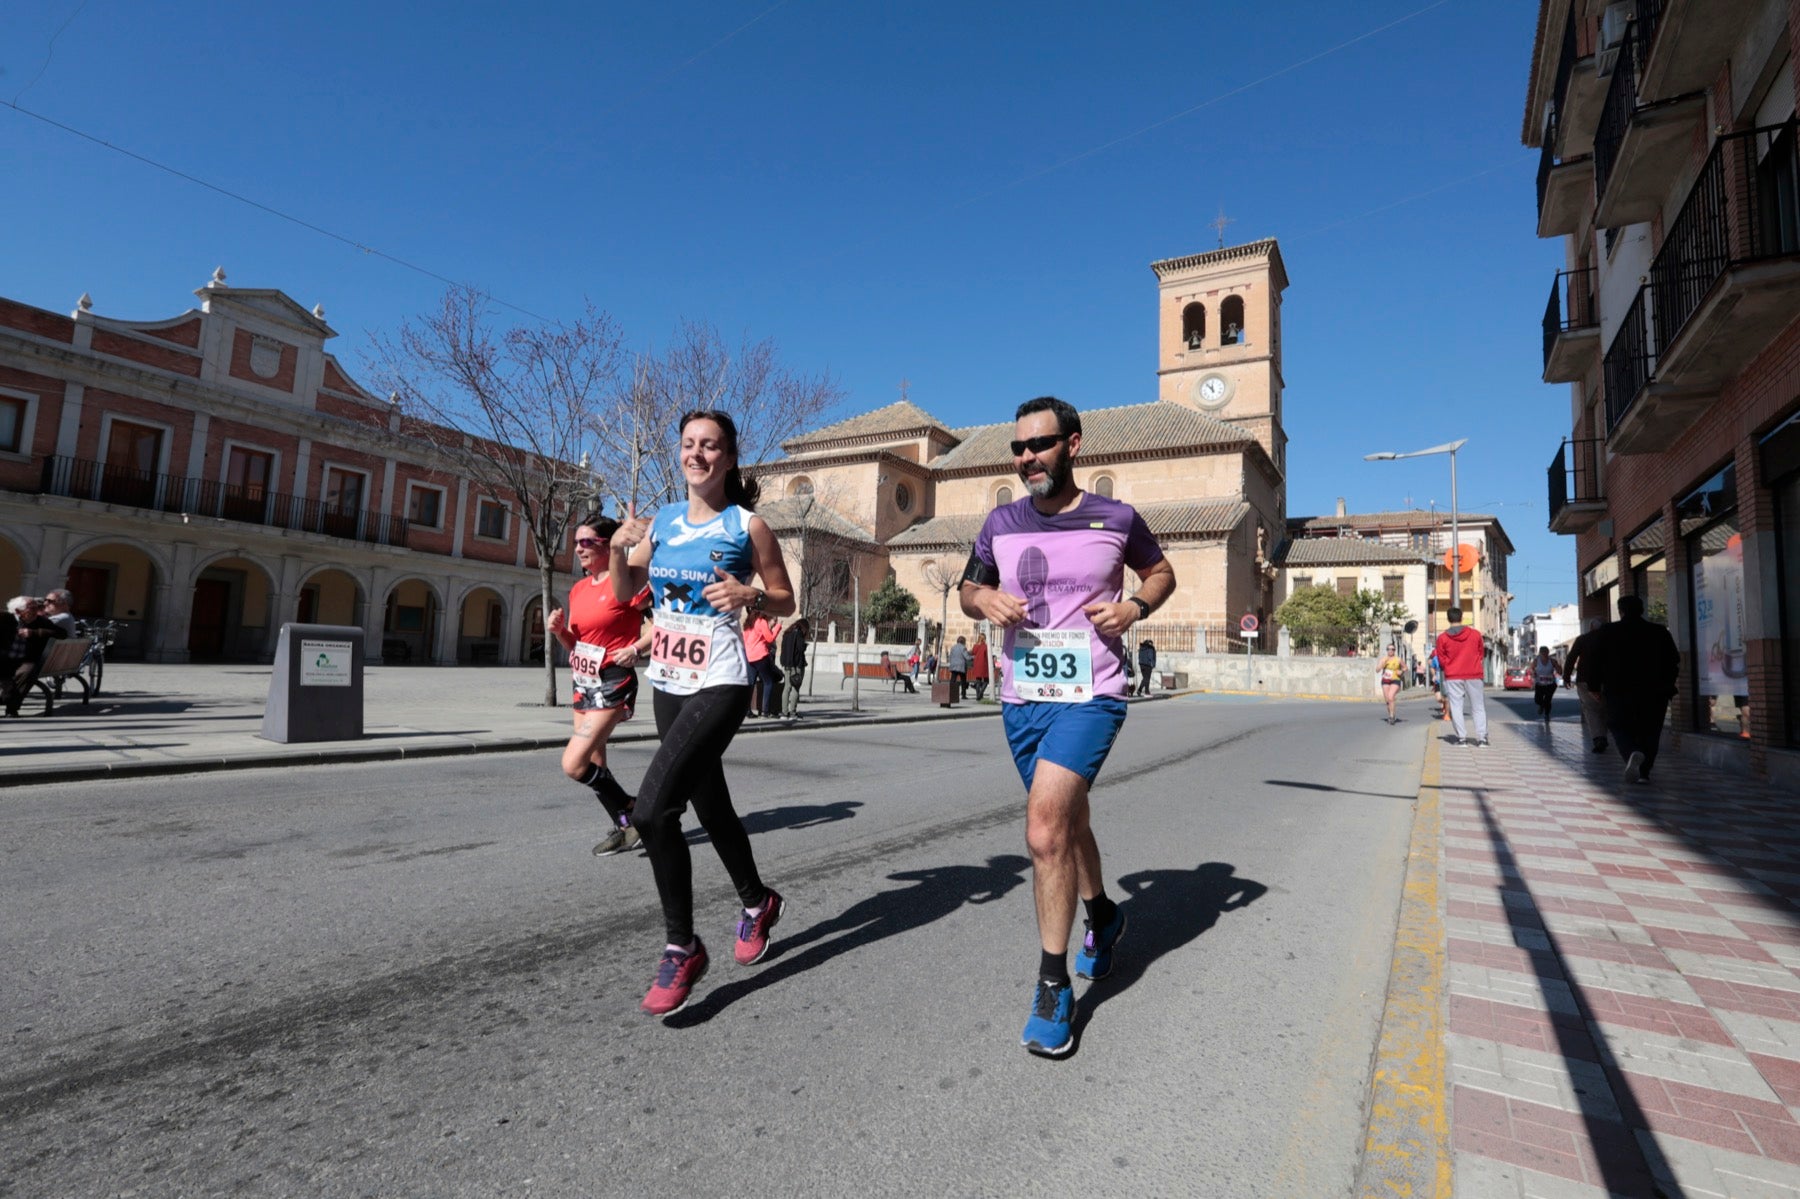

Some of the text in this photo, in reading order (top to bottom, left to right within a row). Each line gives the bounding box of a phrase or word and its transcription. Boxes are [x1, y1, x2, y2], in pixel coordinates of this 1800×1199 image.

[681, 569, 716, 583] SUMA
[653, 631, 705, 665] 2146
[1025, 653, 1077, 679] 593
